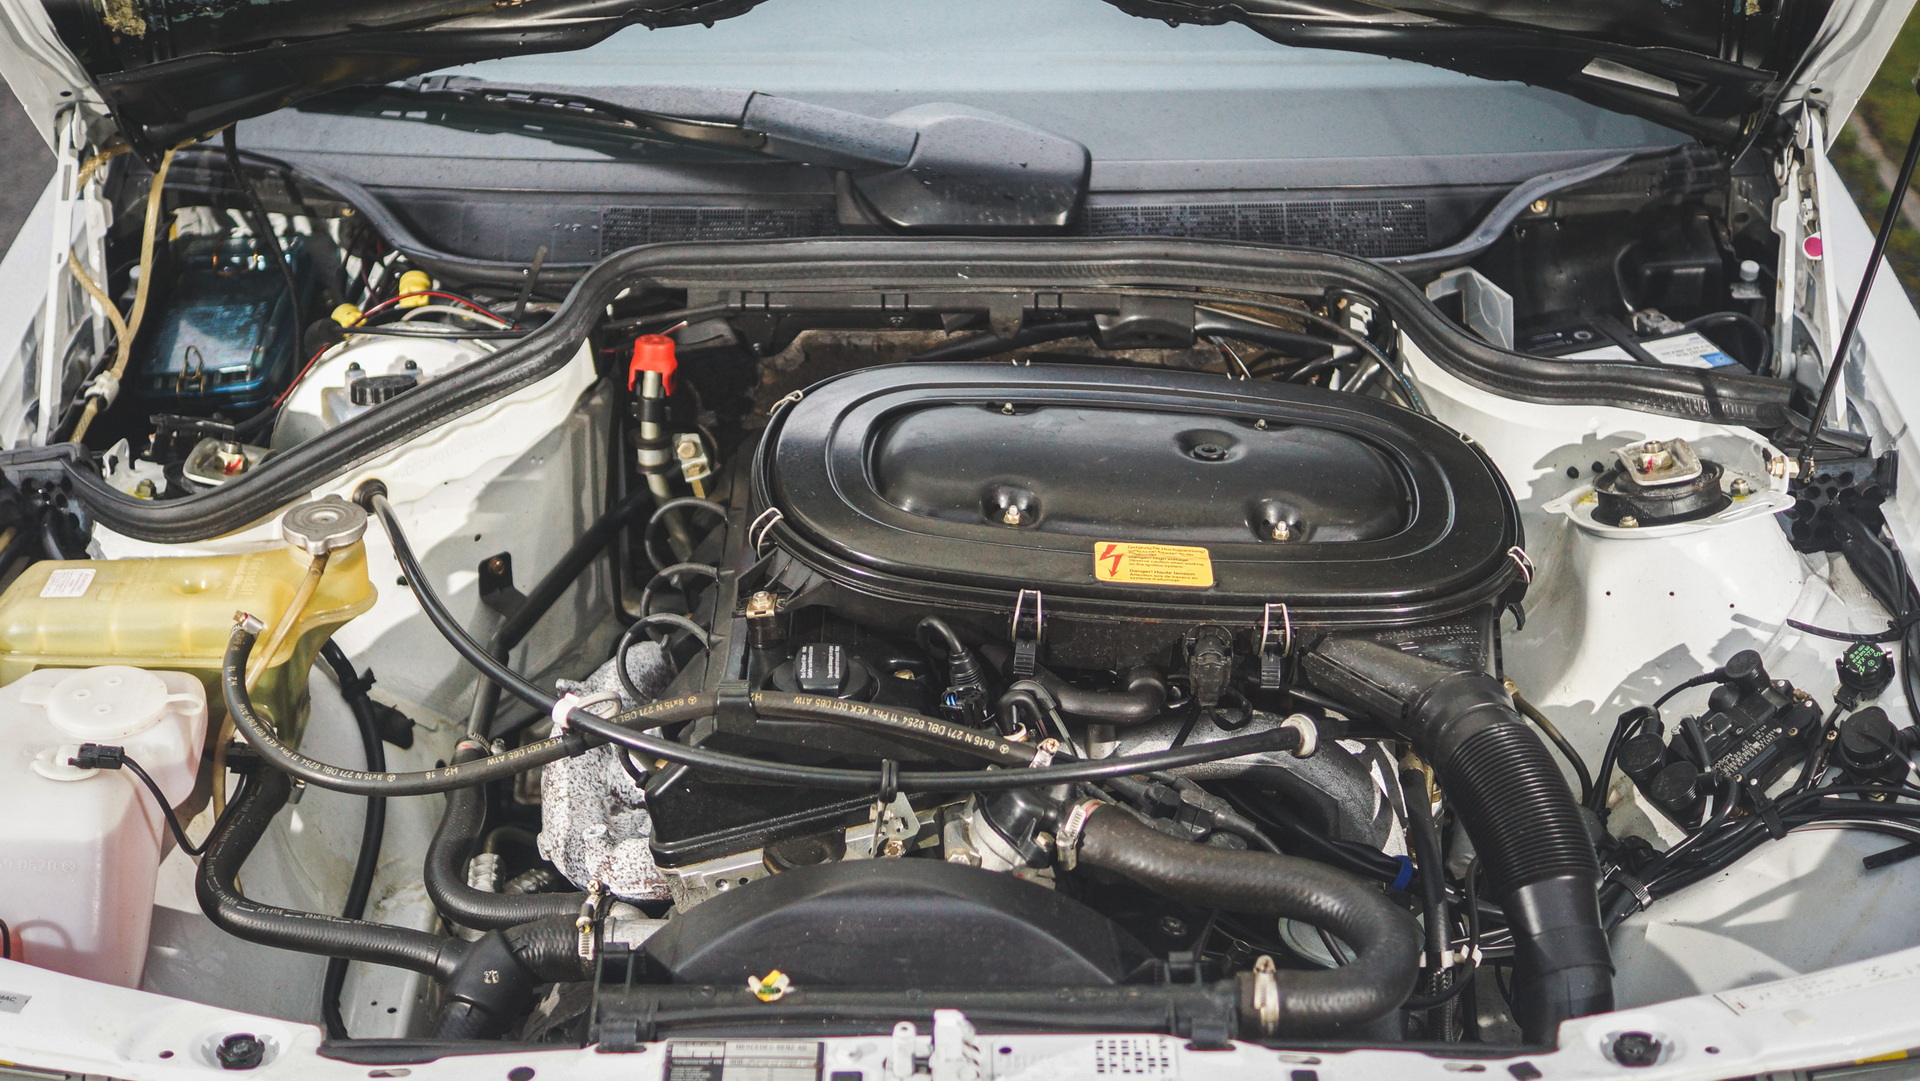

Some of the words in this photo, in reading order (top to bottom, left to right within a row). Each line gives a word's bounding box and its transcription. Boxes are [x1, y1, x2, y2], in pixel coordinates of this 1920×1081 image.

[664, 698, 684, 708] 8x15
[793, 695, 813, 707] A1W
[833, 701, 848, 712] 001
[639, 706, 654, 717] 271
[656, 703, 663, 711] N
[850, 704, 869, 716] KEK
[872, 707, 889, 722] Phx
[927, 721, 946, 736] DBL
[947, 728, 963, 741] 271
[965, 733, 973, 744] N
[263, 735, 279, 748] KEK
[543, 736, 563, 748] KEK
[974, 735, 995, 750] 8x15
[526, 744, 542, 754] 001
[486, 754, 505, 766] A1W
[322, 765, 338, 776] DBL
[339, 769, 353, 779] 271
[355, 772, 363, 780] N
[444, 767, 458, 776] H2
[364, 773, 383, 781] 8x15
